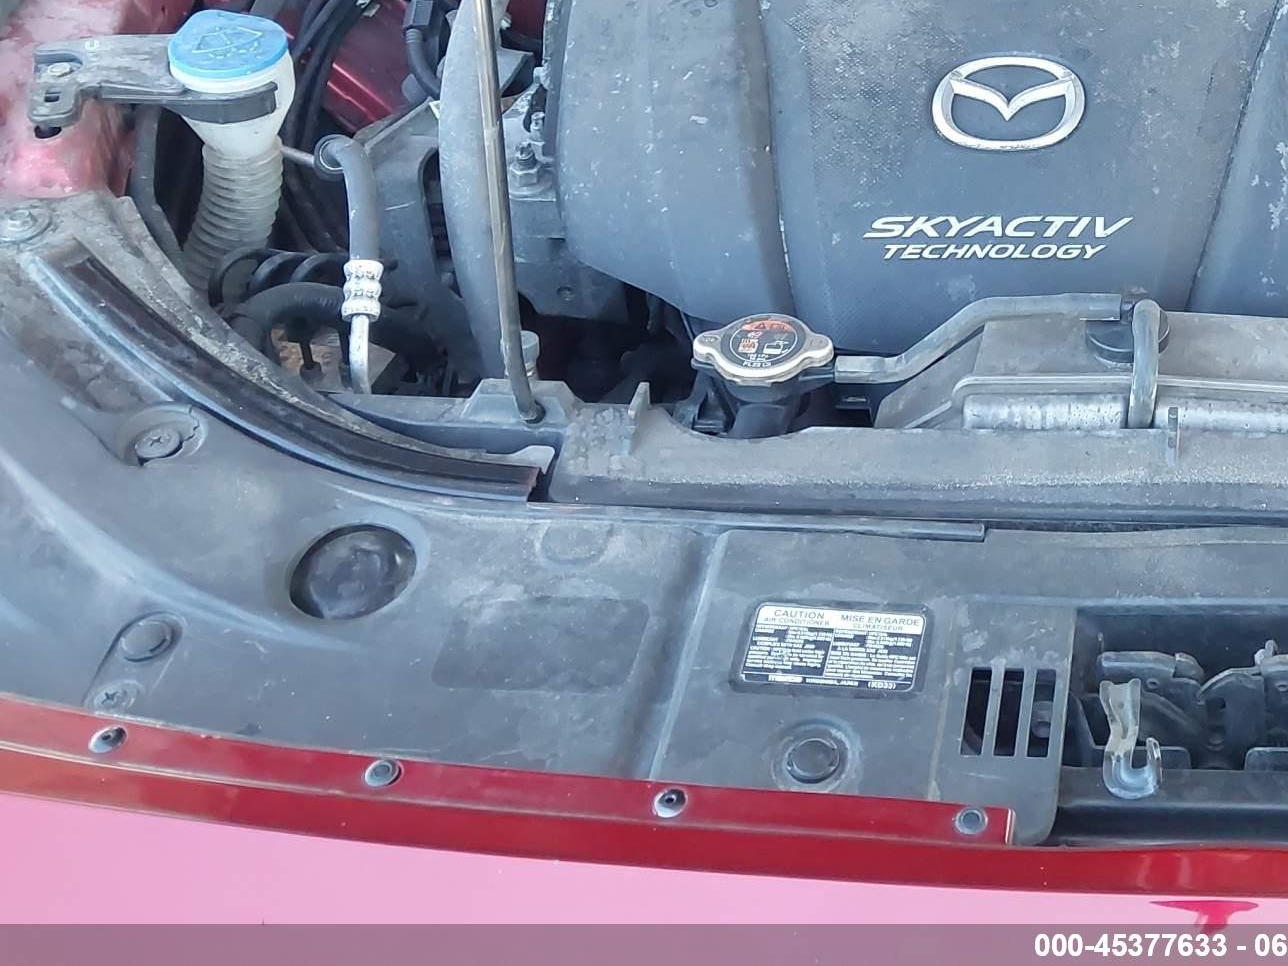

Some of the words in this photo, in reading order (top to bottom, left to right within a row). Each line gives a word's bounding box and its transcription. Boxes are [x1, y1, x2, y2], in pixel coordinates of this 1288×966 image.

[863, 215, 1134, 238] SKYACTIV
[883, 243, 1106, 259] TECHNOLOGY
[774, 609, 825, 620] CAUTION
[840, 614, 865, 623] MISE
[884, 618, 920, 627] GARDE
[778, 618, 830, 626] CONDITIONER
[853, 623, 904, 632] CLIMATISEUR
